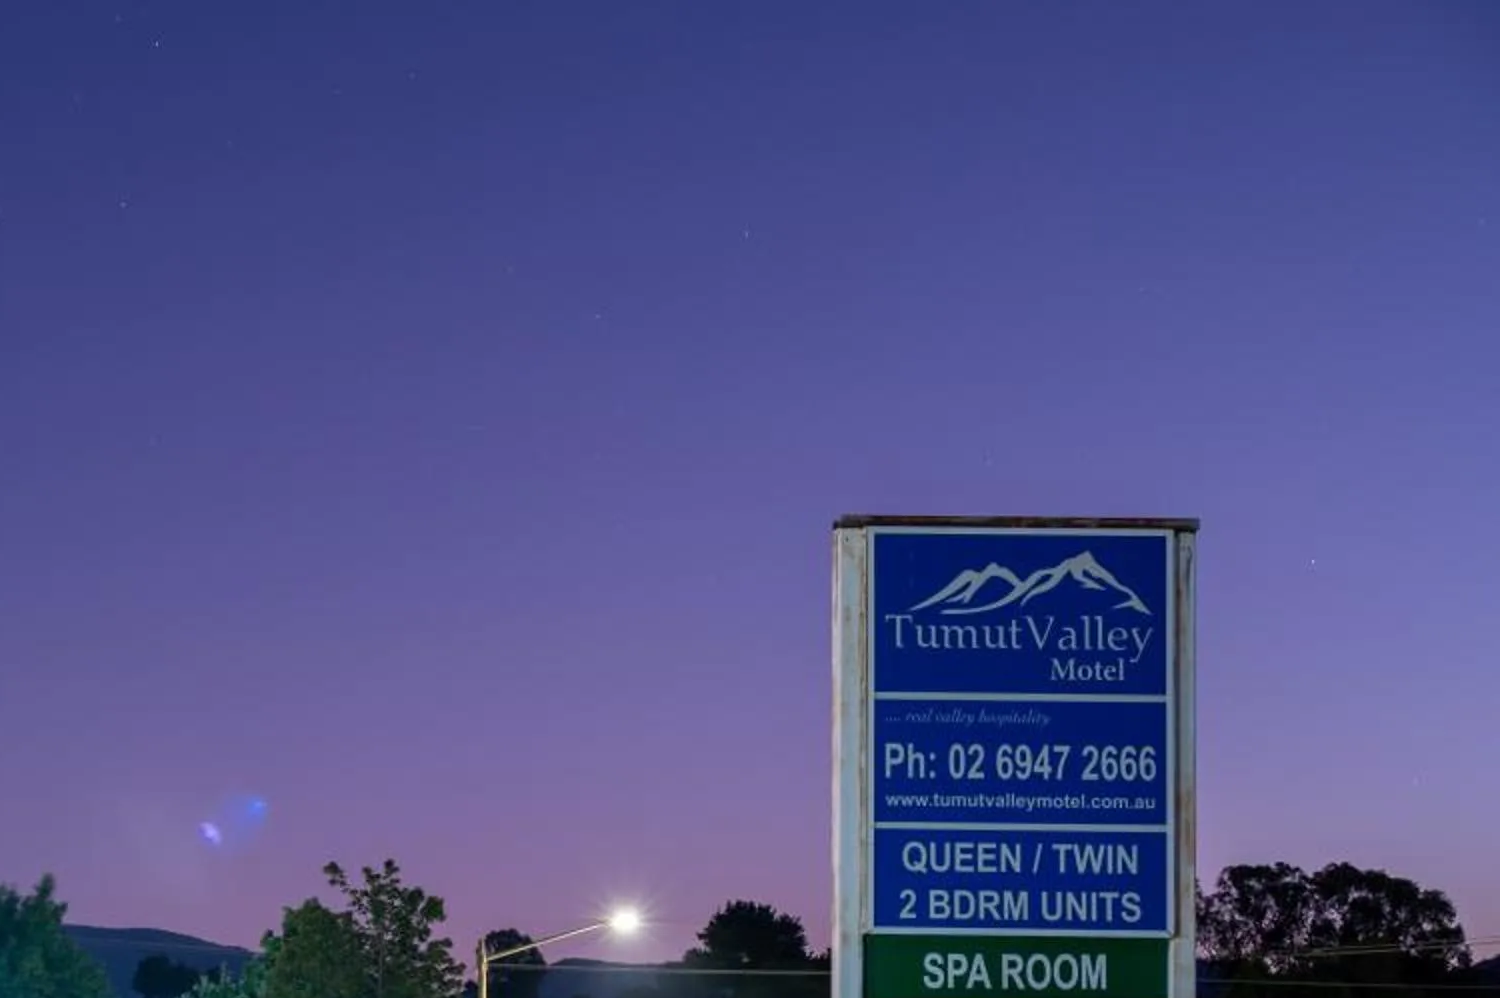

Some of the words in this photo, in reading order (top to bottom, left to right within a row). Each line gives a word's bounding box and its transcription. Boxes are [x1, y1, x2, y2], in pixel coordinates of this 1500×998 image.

[1050, 658, 1126, 681] Motel
[935, 707, 975, 727] valley
[978, 708, 1051, 729] hospitality
[884, 743, 937, 779] Ph:
[948, 744, 985, 779] 02
[996, 744, 1071, 781] 6947
[1081, 745, 1157, 781] 2666
[885, 792, 1156, 812] www.tumutvalleymotel.com.au
[902, 841, 1022, 874] QUEEN
[1032, 843, 1043, 874] /
[1052, 844, 1138, 875] TWIN
[899, 889, 917, 919] 2
[929, 889, 1029, 921] BDRM
[1041, 891, 1142, 923] UNITS
[923, 953, 992, 989] SPA
[1001, 954, 1108, 990] ROOM
